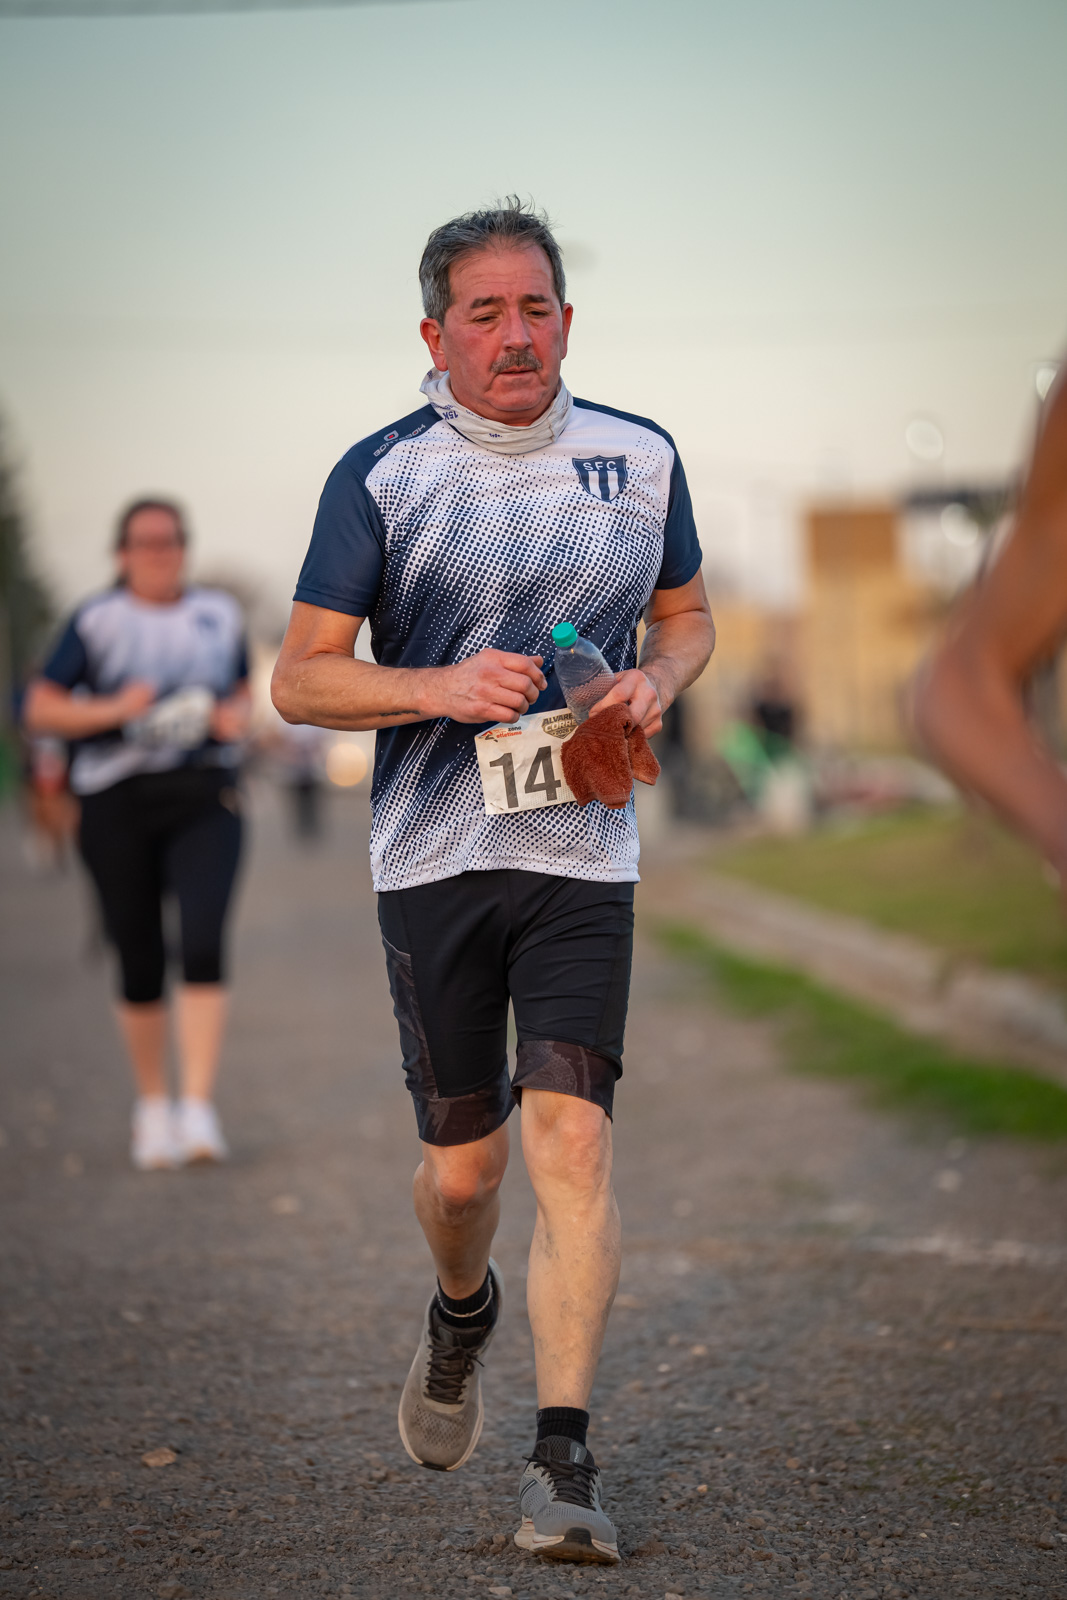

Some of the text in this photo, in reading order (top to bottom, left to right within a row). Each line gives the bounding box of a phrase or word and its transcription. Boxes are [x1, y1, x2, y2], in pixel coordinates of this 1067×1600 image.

[583, 460, 617, 471] SFC
[543, 713, 574, 725] ALVARE
[489, 746, 561, 808] 14
